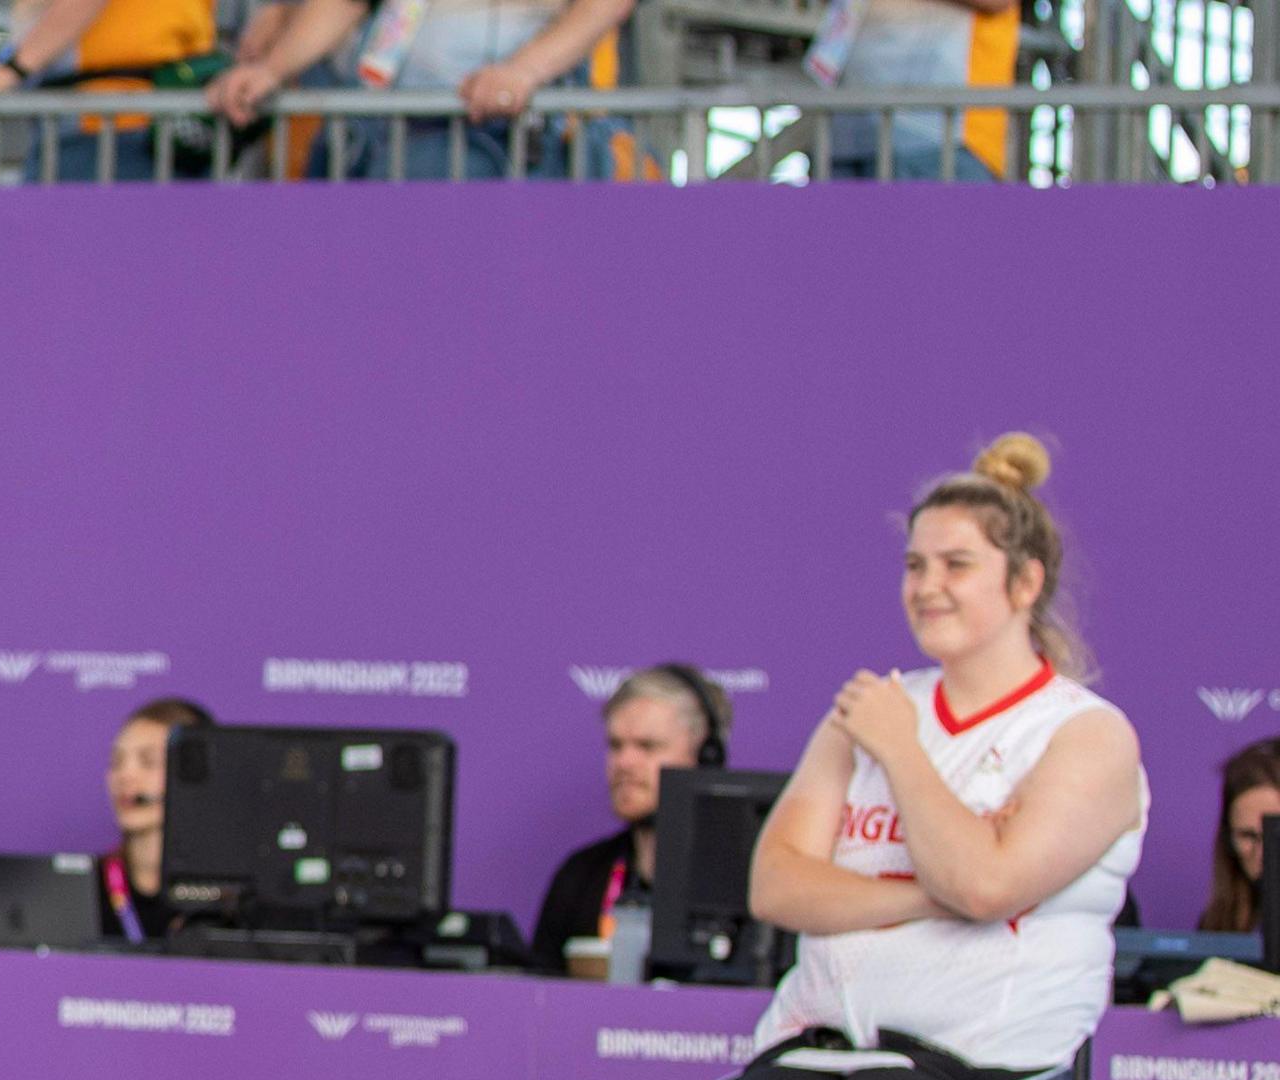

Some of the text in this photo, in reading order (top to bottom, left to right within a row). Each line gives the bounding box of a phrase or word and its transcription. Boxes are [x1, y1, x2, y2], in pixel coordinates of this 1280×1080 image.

[262, 657, 469, 698] BIRMINGHAM 2022
[58, 995, 184, 1032] BIRMINGHAM
[596, 1026, 729, 1064] BIRMINGHAM
